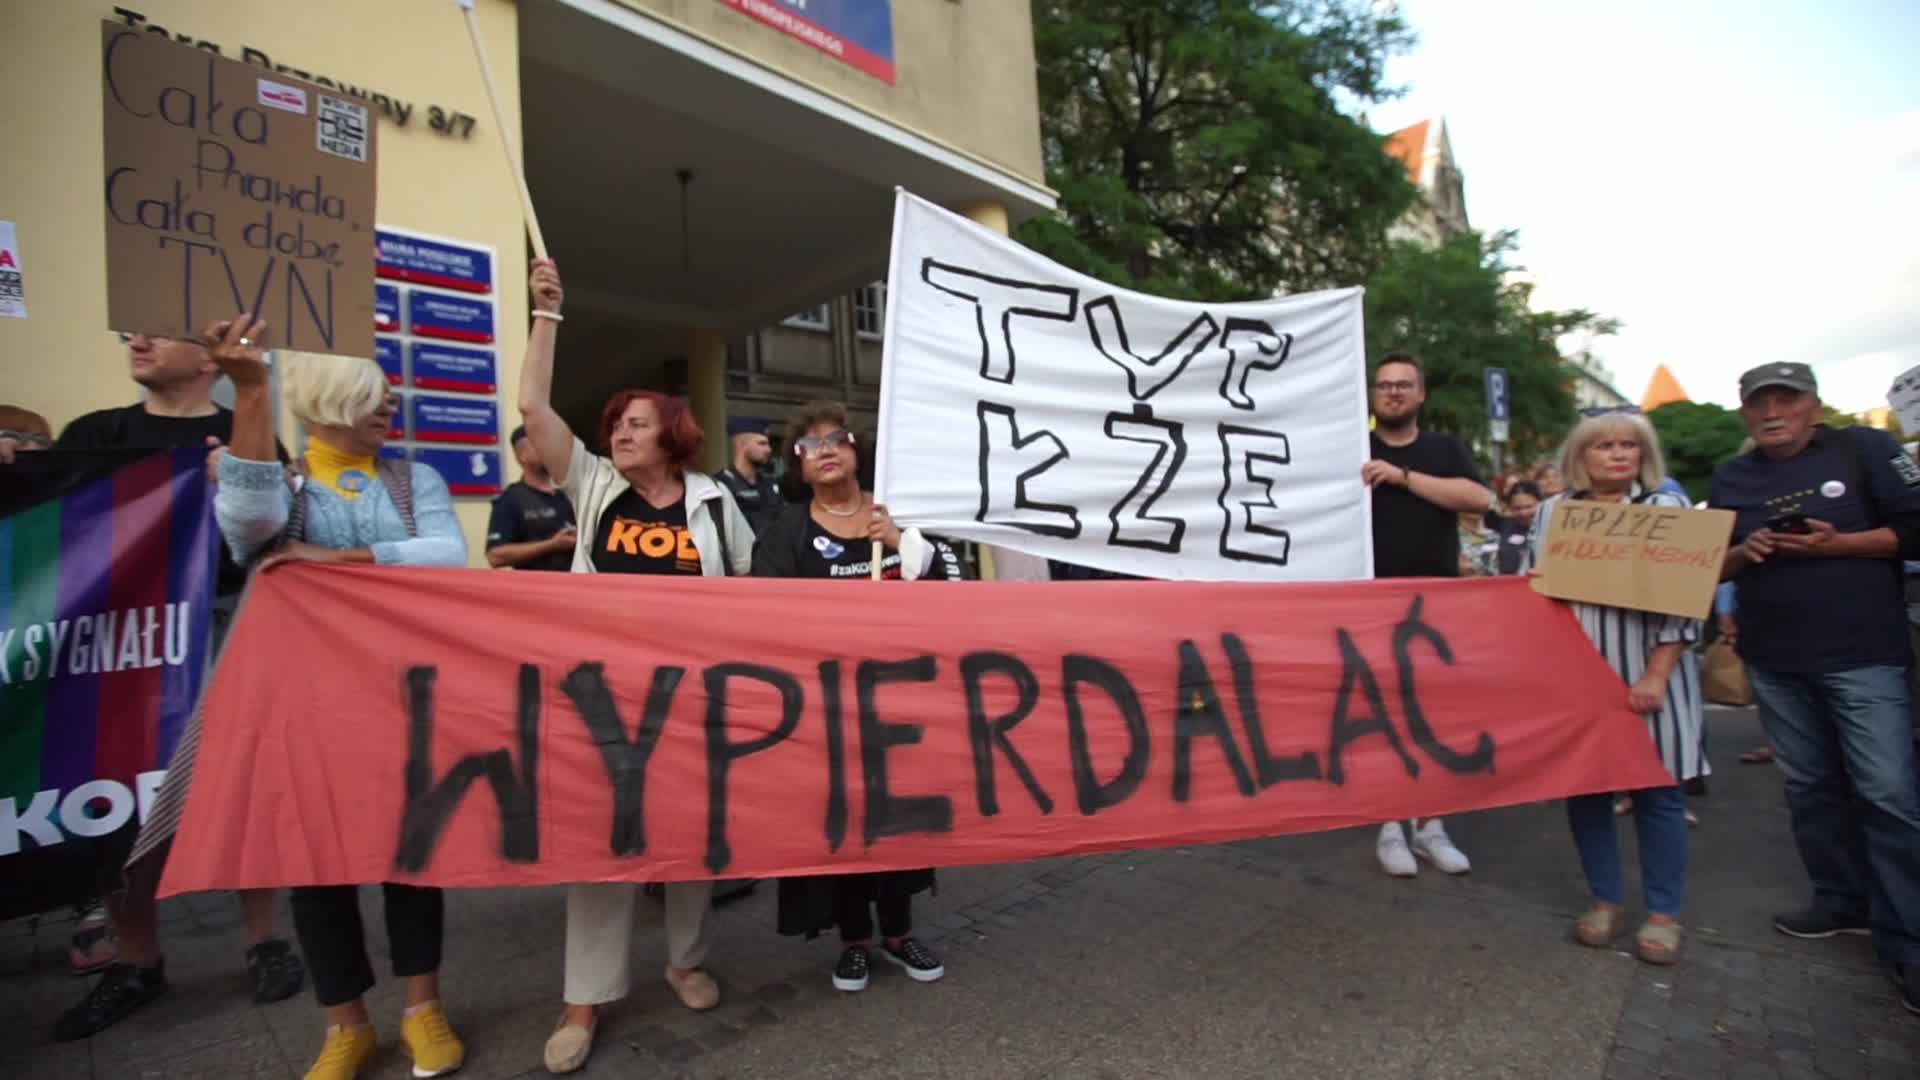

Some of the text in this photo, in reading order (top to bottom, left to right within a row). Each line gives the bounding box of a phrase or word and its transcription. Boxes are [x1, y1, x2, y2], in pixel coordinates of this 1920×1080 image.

[105, 32, 269, 146] Cała
[427, 104, 477, 139] 3/7
[105, 166, 217, 241] Cała
[159, 235, 334, 349] TVN
[921, 257, 1293, 411] TVP
[23, 601, 190, 682] SYGNAŁU
[394, 595, 1496, 874] WYPIERDALAĆ
